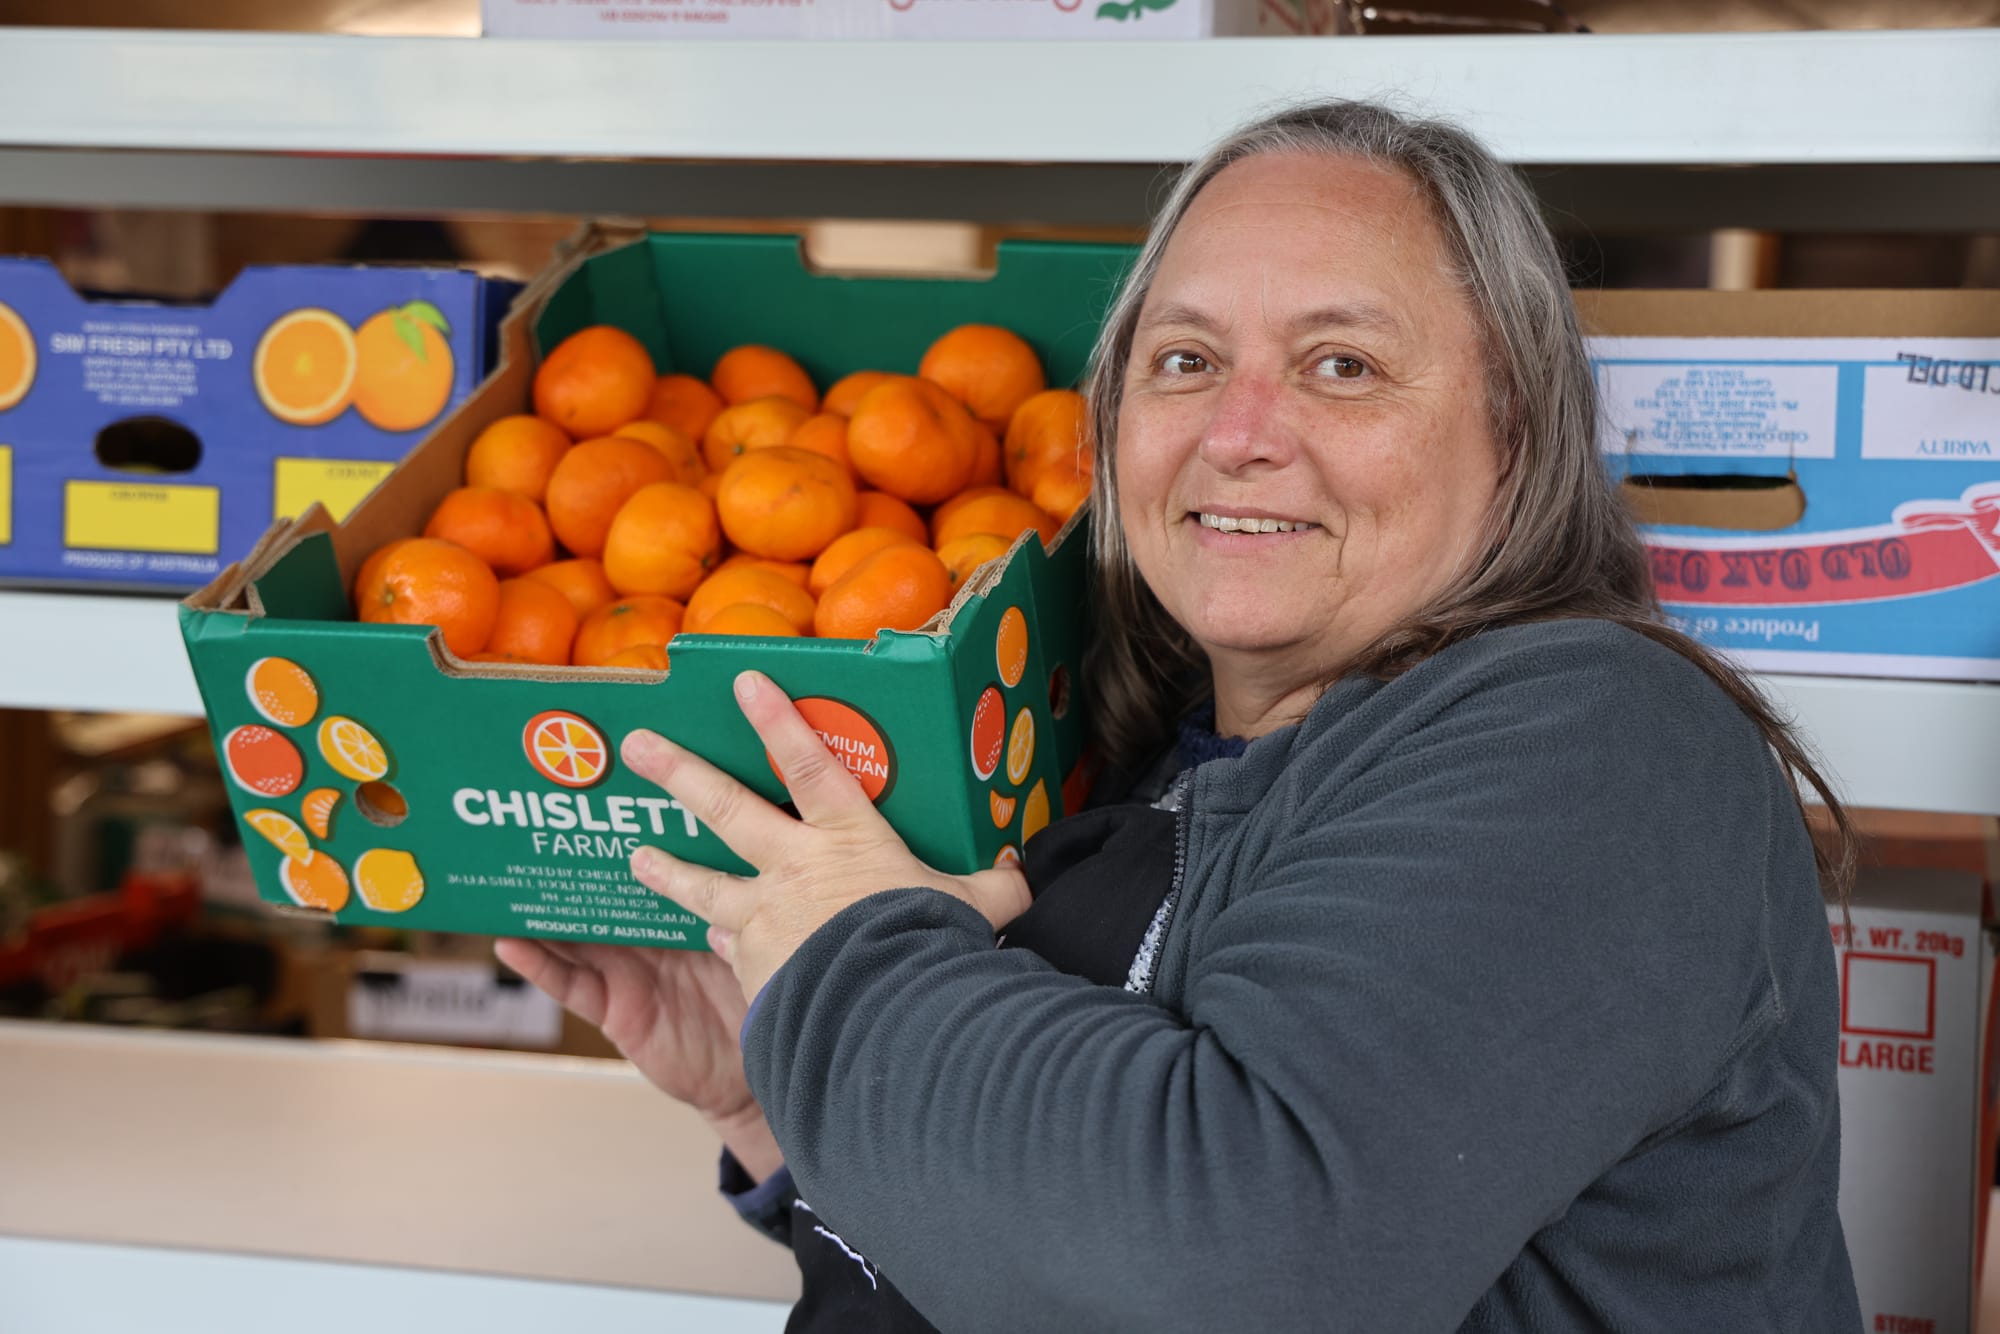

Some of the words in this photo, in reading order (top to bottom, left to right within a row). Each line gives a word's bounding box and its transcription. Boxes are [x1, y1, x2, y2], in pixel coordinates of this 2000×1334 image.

[88, 335, 153, 356] FRESH
[155, 337, 194, 357] PTY
[194, 339, 233, 360] LTD
[1916, 439, 1991, 457] VARIETY
[128, 554, 145, 570] OF
[148, 555, 219, 574] AUSTRALIA
[1720, 549, 1811, 591] OAK
[1821, 538, 1912, 581] OLD
[1695, 616, 1719, 637] of
[1724, 617, 1820, 642] Produce
[452, 787, 699, 838] CHISLETT
[531, 832, 641, 859] FARMS
[506, 864, 556, 878] PACKED
[617, 884, 647, 896] NSW
[525, 919, 588, 935] PRODUCT
[592, 924, 611, 936] OF
[614, 927, 687, 942] AUSTRALIA
[1915, 930, 1966, 959] 20kg
[1839, 1038, 1936, 1074] LARGE
